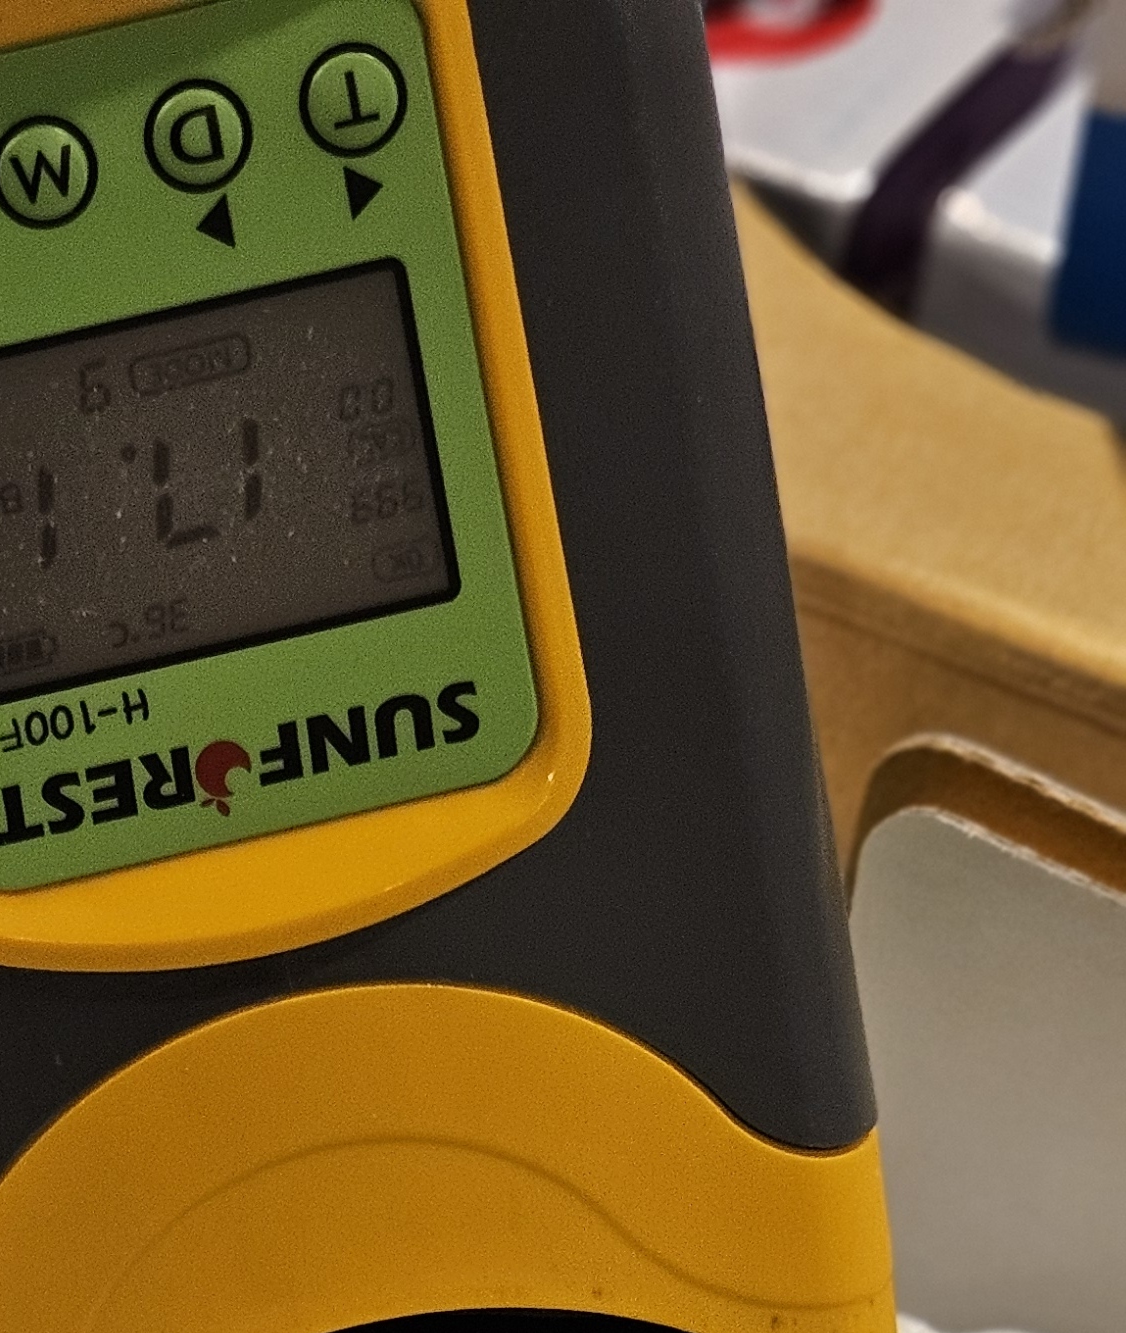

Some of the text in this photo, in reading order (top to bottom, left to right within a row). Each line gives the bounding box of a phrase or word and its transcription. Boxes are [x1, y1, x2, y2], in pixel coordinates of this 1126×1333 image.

[332, 70, 379, 128] T
[168, 104, 223, 160] D
[9, 142, 73, 200] M
[35, 419, 263, 571] 17.1
